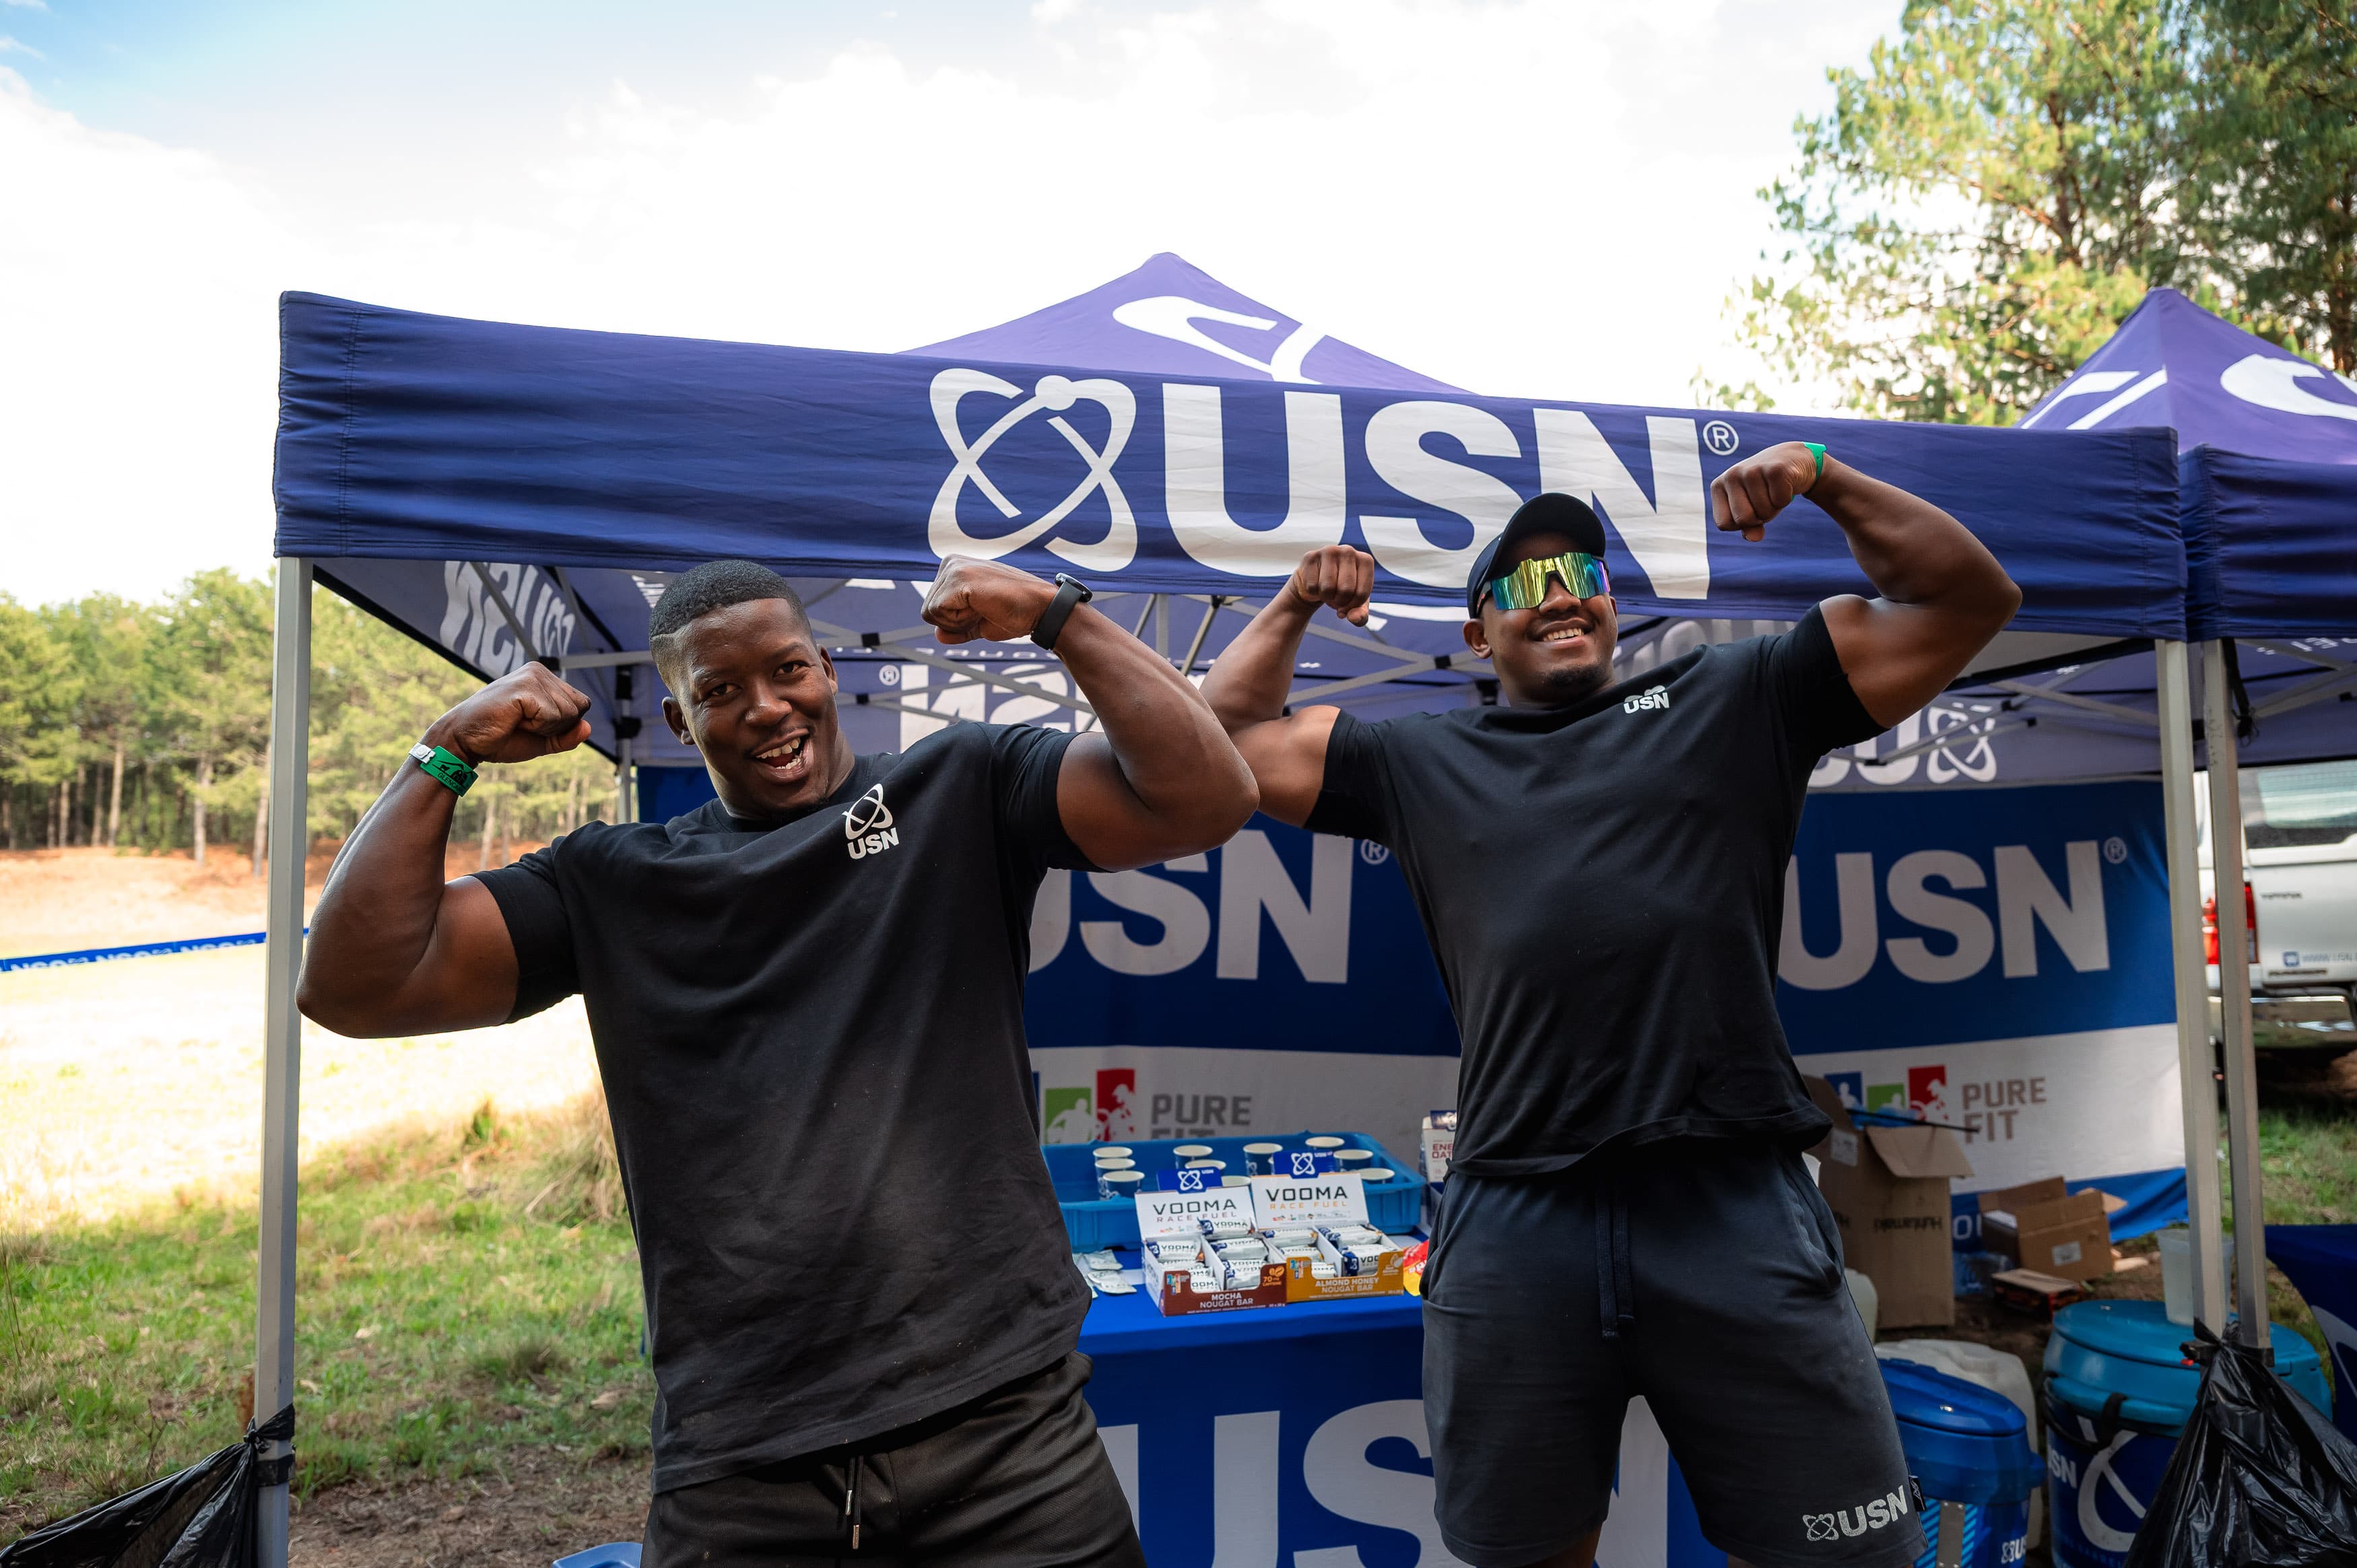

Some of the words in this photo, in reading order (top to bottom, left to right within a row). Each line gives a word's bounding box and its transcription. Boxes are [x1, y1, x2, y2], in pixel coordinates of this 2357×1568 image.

[1623, 691, 1670, 714] USN
[846, 827, 900, 860] USN
[1962, 1077, 2047, 1110] PURE
[1152, 1094, 1252, 1126] PURE
[1964, 1107, 2019, 1144] FIT
[1266, 1186, 1348, 1202] VOOMA
[1153, 1199, 1236, 1215] VOOMA
[1269, 1202, 1304, 1211] RACE
[1314, 1200, 1348, 1208] FUEL
[1156, 1215, 1193, 1223] RACE
[1202, 1211, 1237, 1219] FUEL
[1360, 1255, 1380, 1264] VOO
[1315, 1279, 1350, 1287] ALMOND
[1322, 1285, 1354, 1293] NOUGAT
[1357, 1283, 1374, 1291] BAR
[1199, 1299, 1235, 1309] NOUGAT
[1211, 1293, 1242, 1301] MOCHA
[1836, 1485, 1908, 1537] USN
